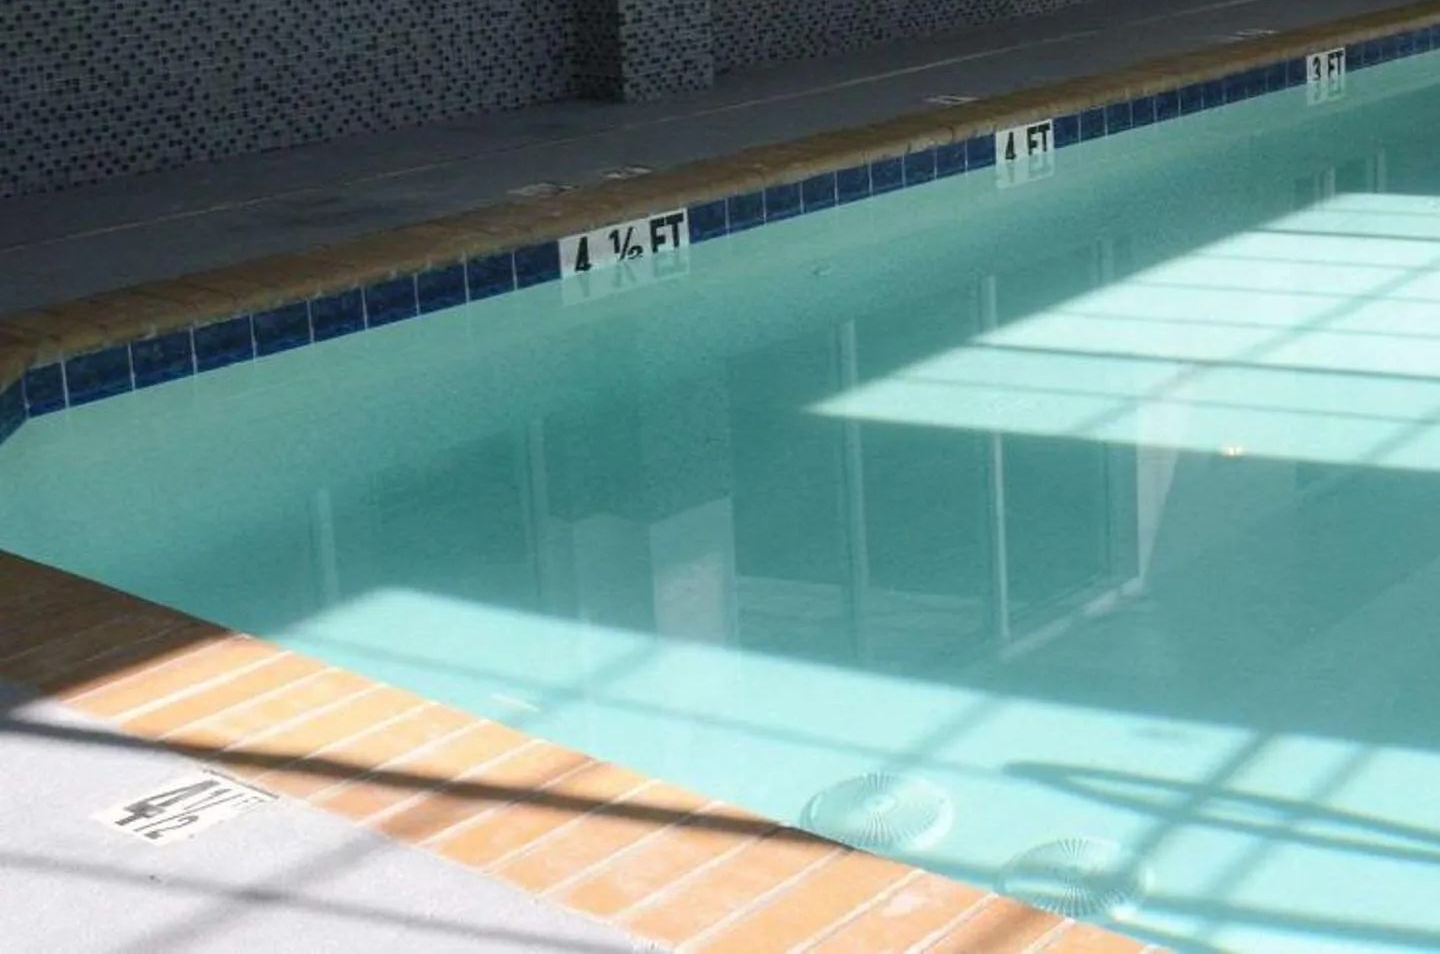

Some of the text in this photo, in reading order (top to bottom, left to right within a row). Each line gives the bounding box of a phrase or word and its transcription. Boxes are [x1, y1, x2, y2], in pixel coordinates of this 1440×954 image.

[1328, 50, 1344, 78] FT
[1005, 122, 1051, 160] 4 FT
[575, 235, 592, 272] 4
[649, 212, 684, 253] FT
